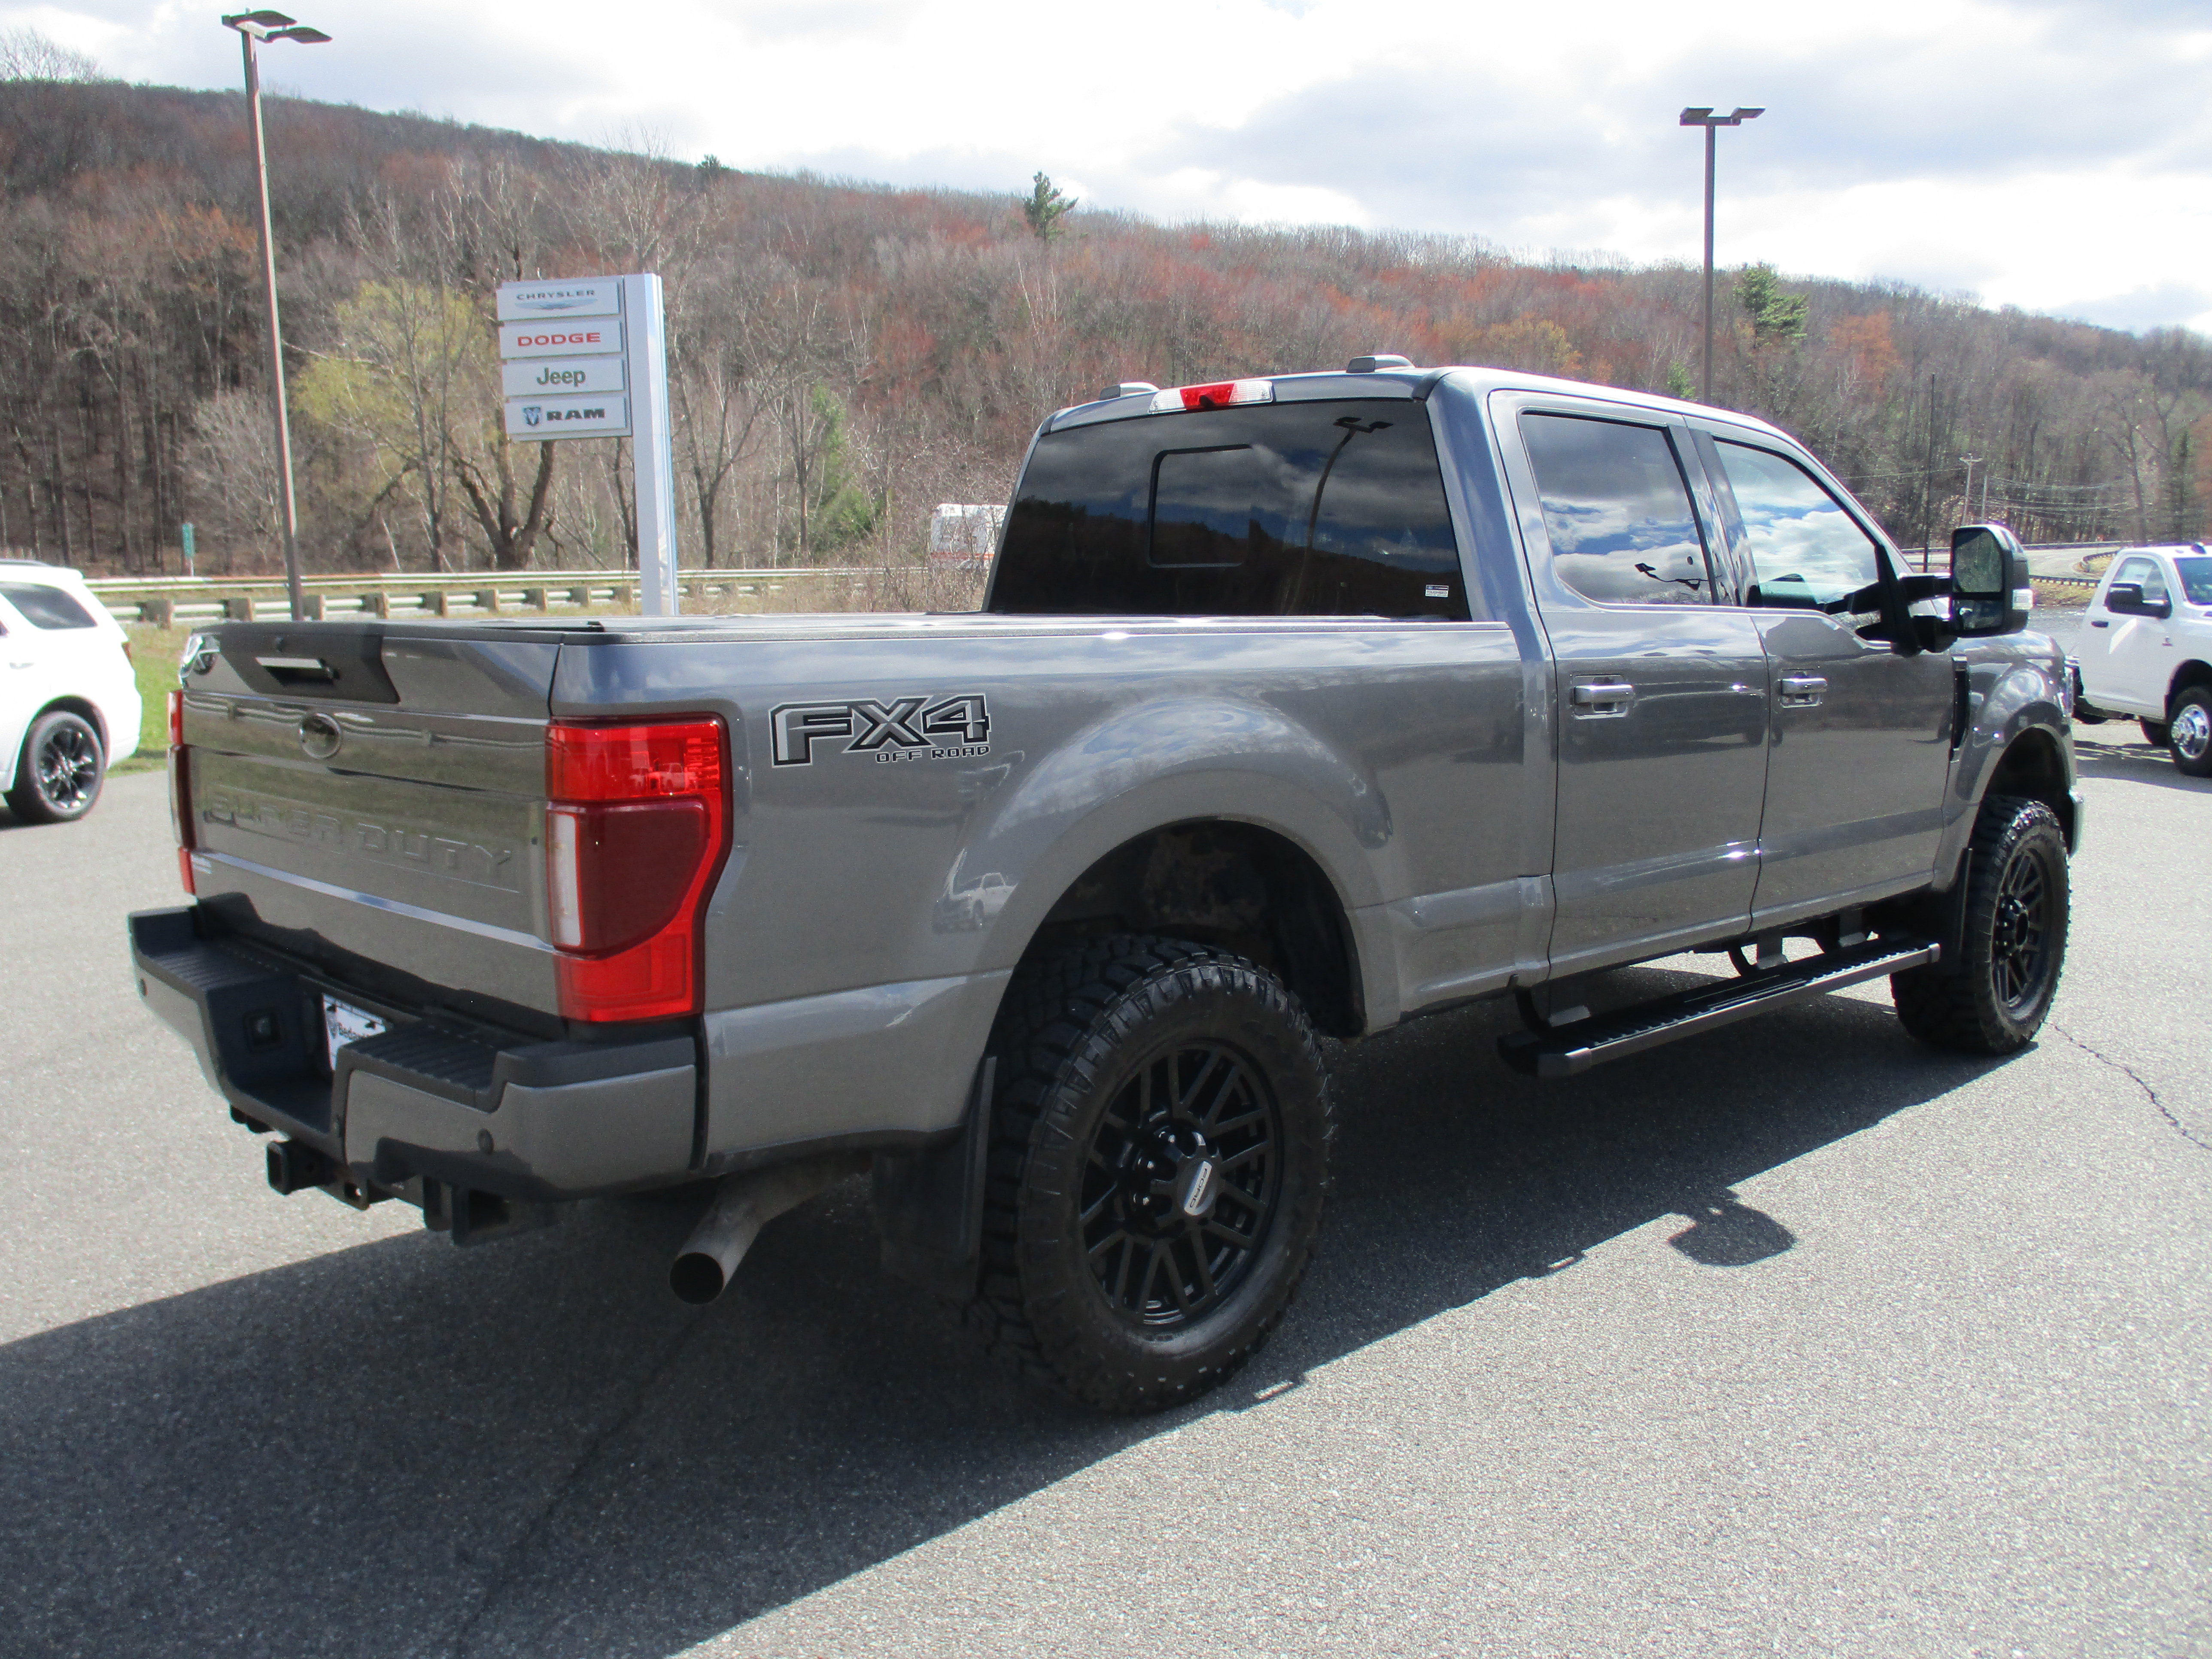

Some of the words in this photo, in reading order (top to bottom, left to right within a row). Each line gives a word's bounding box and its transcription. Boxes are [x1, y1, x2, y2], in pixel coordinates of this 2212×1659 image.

[516, 289, 595, 300] CHRYSLER
[517, 332, 601, 346] DODGE
[536, 368, 586, 386] Jeep
[546, 408, 605, 421] RAM
[768, 693, 991, 768] FX4
[875, 749, 922, 763] OFF
[931, 745, 991, 760] ROAD
[356, 821, 513, 878] DUTY
